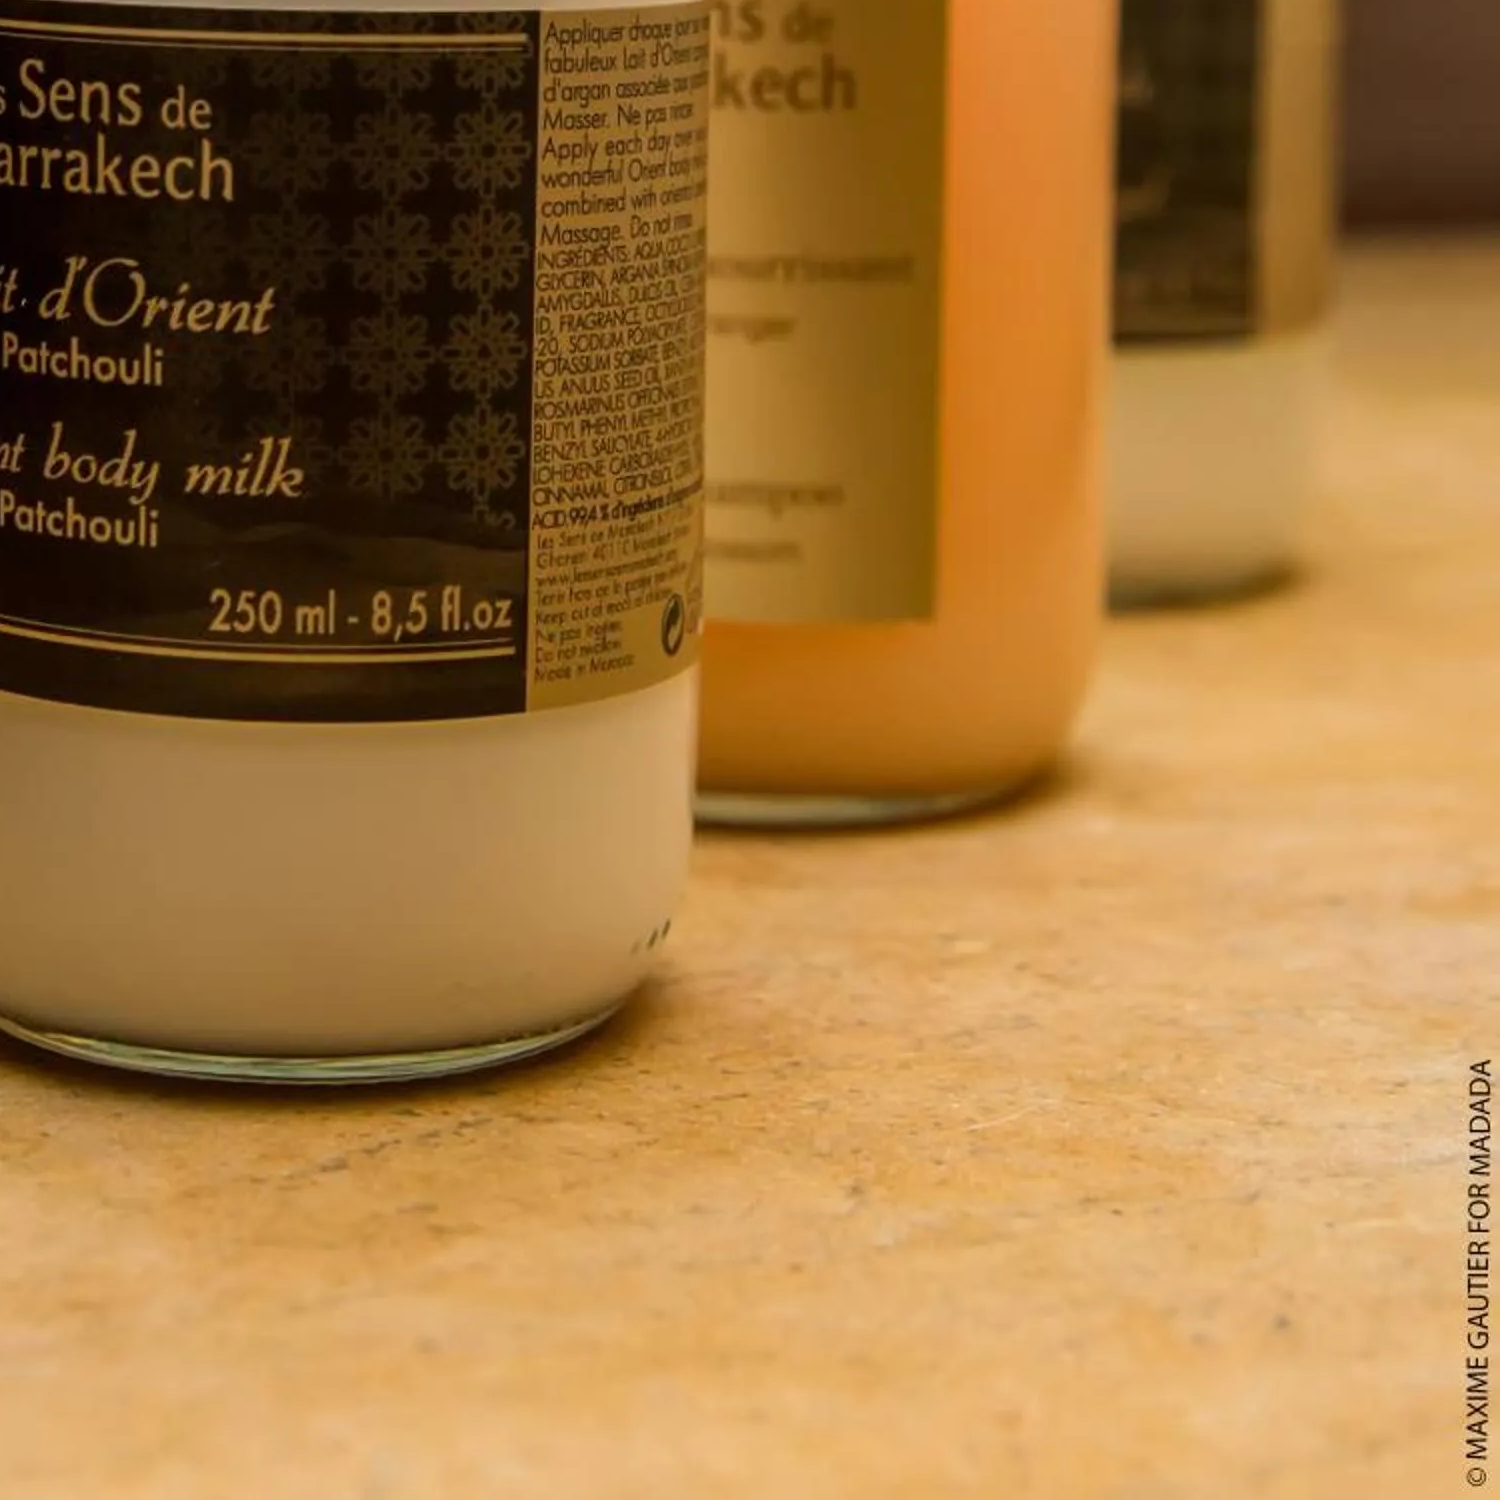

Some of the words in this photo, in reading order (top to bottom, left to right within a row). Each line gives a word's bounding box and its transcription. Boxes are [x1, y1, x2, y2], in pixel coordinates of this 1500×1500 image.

[544, 46, 617, 77] fabuleux
[713, 50, 859, 114] kech
[17, 58, 143, 128] Sens
[160, 82, 214, 131] de
[543, 76, 612, 109] d'argan
[617, 103, 642, 128] Ne
[542, 132, 599, 173] Apply
[604, 131, 643, 157] each
[647, 127, 671, 157] day
[540, 186, 627, 219] combined
[38, 255, 277, 338] d'Orient
[1, 331, 165, 388] Patchouli
[42, 421, 162, 507] body
[182, 436, 308, 501] milk
[208, 590, 282, 636] 250
[295, 590, 336, 637] ml
[370, 592, 430, 644] 8,5
[440, 583, 515, 635] fl.oz
